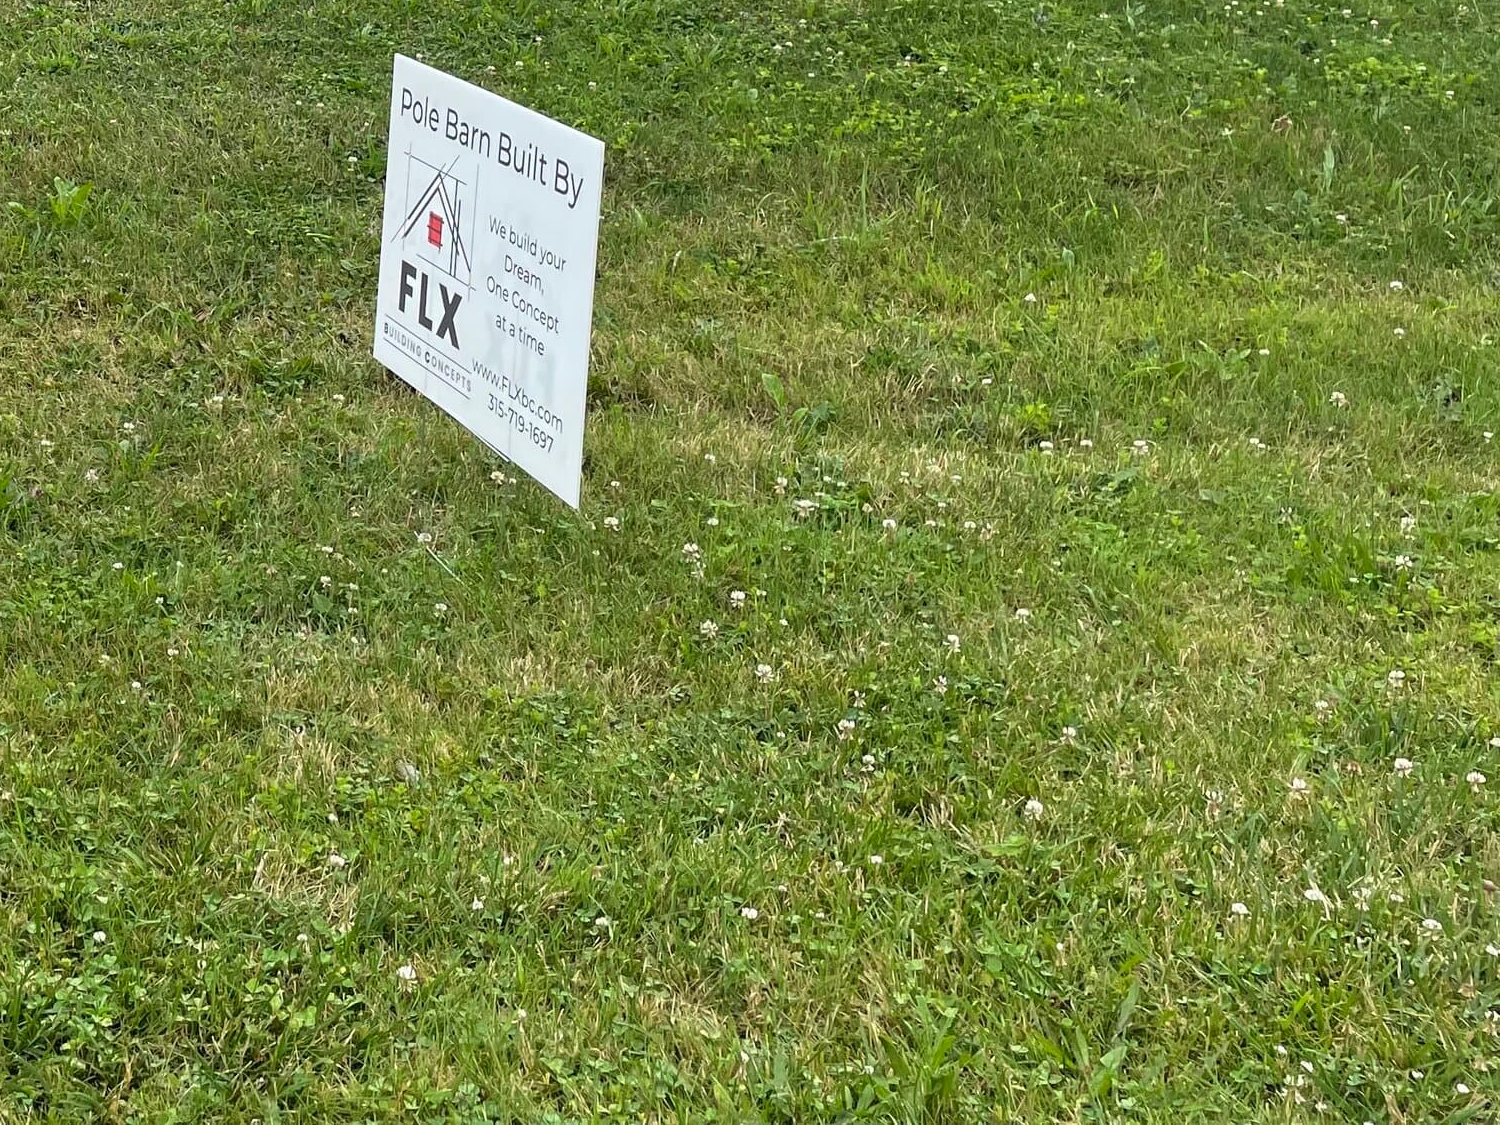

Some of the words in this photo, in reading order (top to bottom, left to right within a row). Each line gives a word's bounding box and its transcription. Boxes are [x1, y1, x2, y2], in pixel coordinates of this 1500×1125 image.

[401, 87, 440, 132] Pole
[446, 107, 491, 159] Barn
[498, 132, 547, 186] Built
[554, 159, 584, 209] By
[489, 215, 506, 239] We
[509, 225, 538, 256] build
[539, 246, 566, 272] your
[398, 259, 463, 351] FLX
[486, 275, 509, 302] One
[512, 291, 560, 334] Concept
[495, 315, 506, 332] at
[509, 323, 516, 337] a
[518, 326, 545, 356] time
[384, 322, 422, 357] BUILDING
[424, 351, 472, 393] CONCEPTS
[472, 358, 563, 434] www.FLXbc.com
[488, 393, 554, 453] 315-719-1697
